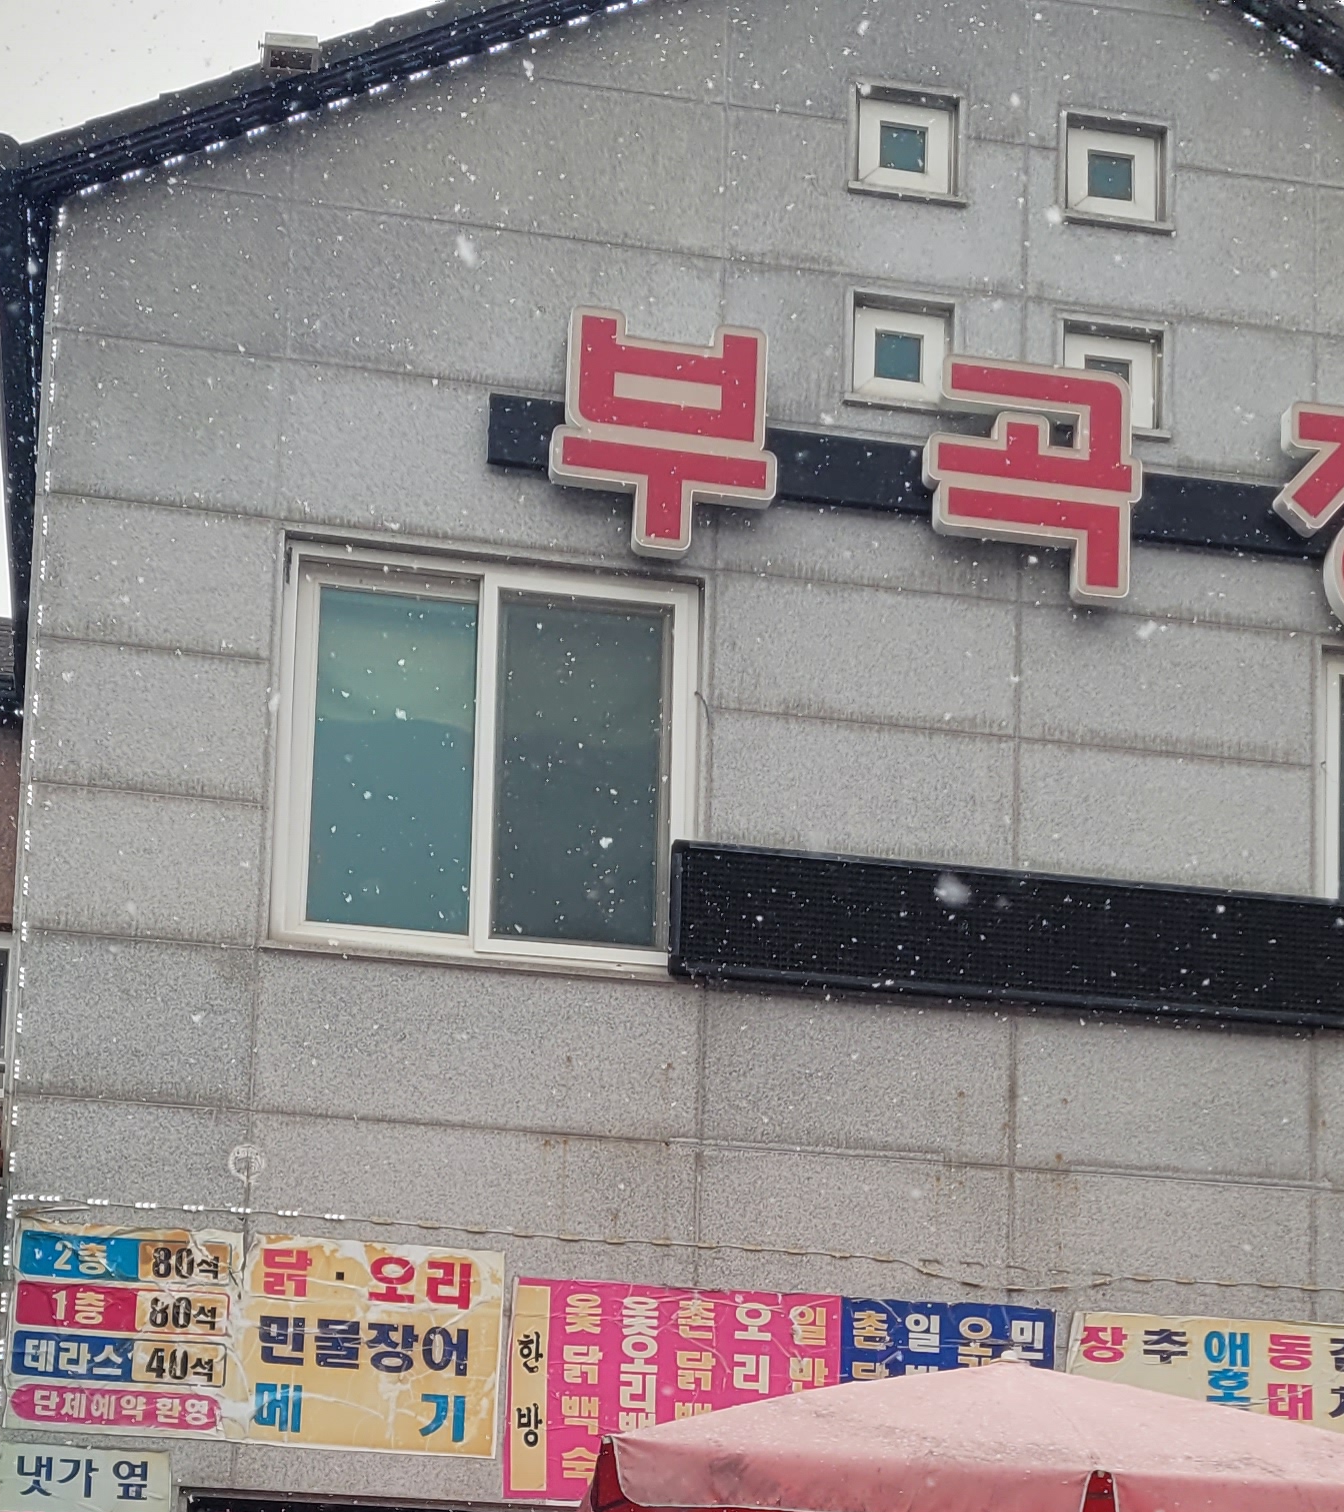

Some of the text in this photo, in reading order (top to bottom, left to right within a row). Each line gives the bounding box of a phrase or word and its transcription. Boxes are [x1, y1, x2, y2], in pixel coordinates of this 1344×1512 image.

[54, 1241, 220, 1281] 2층 80석
[55, 1290, 104, 1325] 1층
[24, 1338, 216, 1383] 테라스 40석
[258, 1316, 469, 1377] 민물장어
[33, 1389, 215, 1427] 단체예약 환영
[17, 1455, 149, 1500] 냇가 옆
